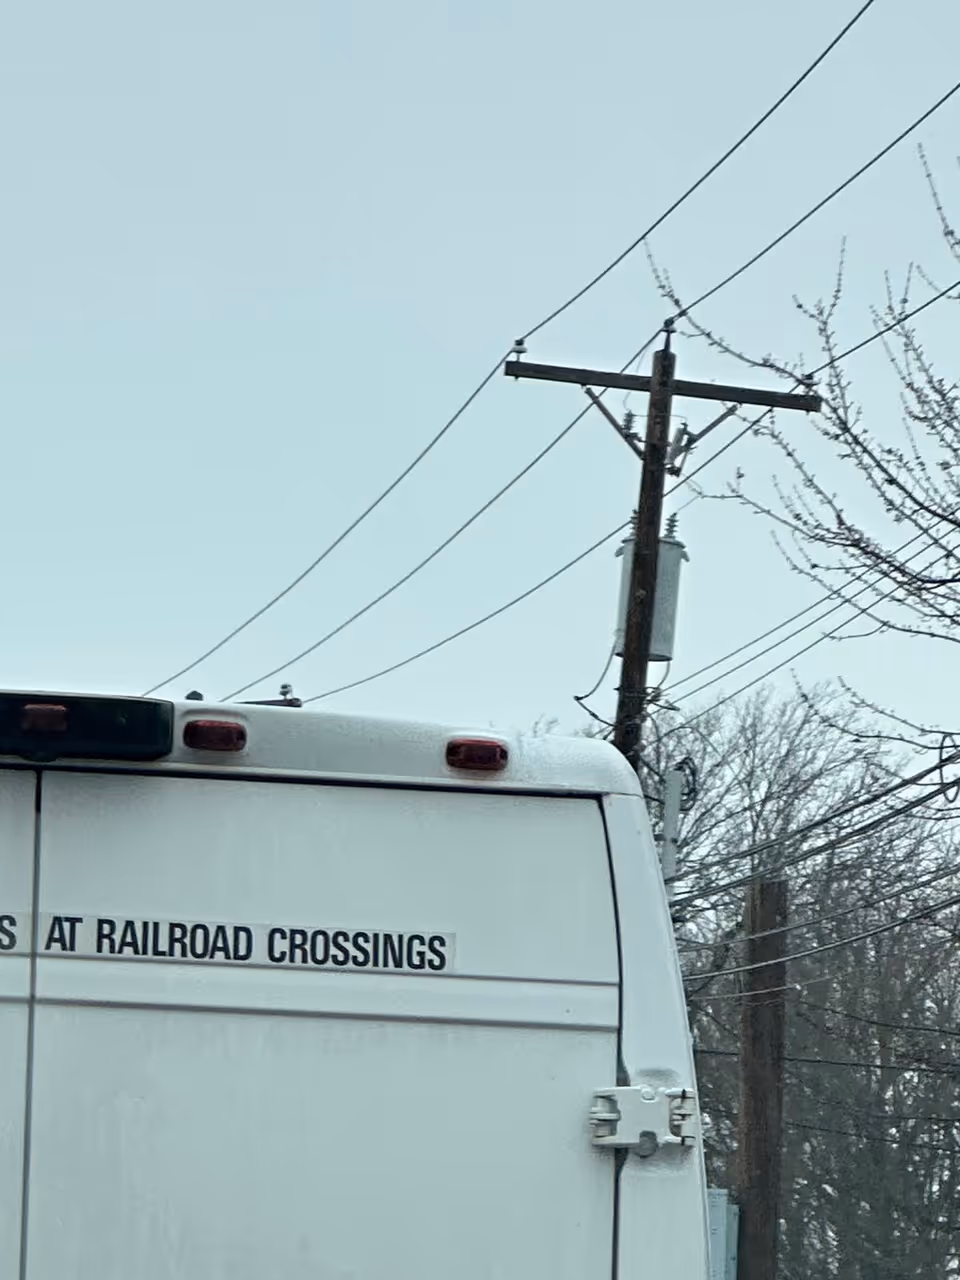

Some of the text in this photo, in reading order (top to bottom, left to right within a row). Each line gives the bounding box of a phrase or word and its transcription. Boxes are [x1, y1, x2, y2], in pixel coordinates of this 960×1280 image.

[45, 916, 447, 971] AT RAILROAD CROSSINGS
